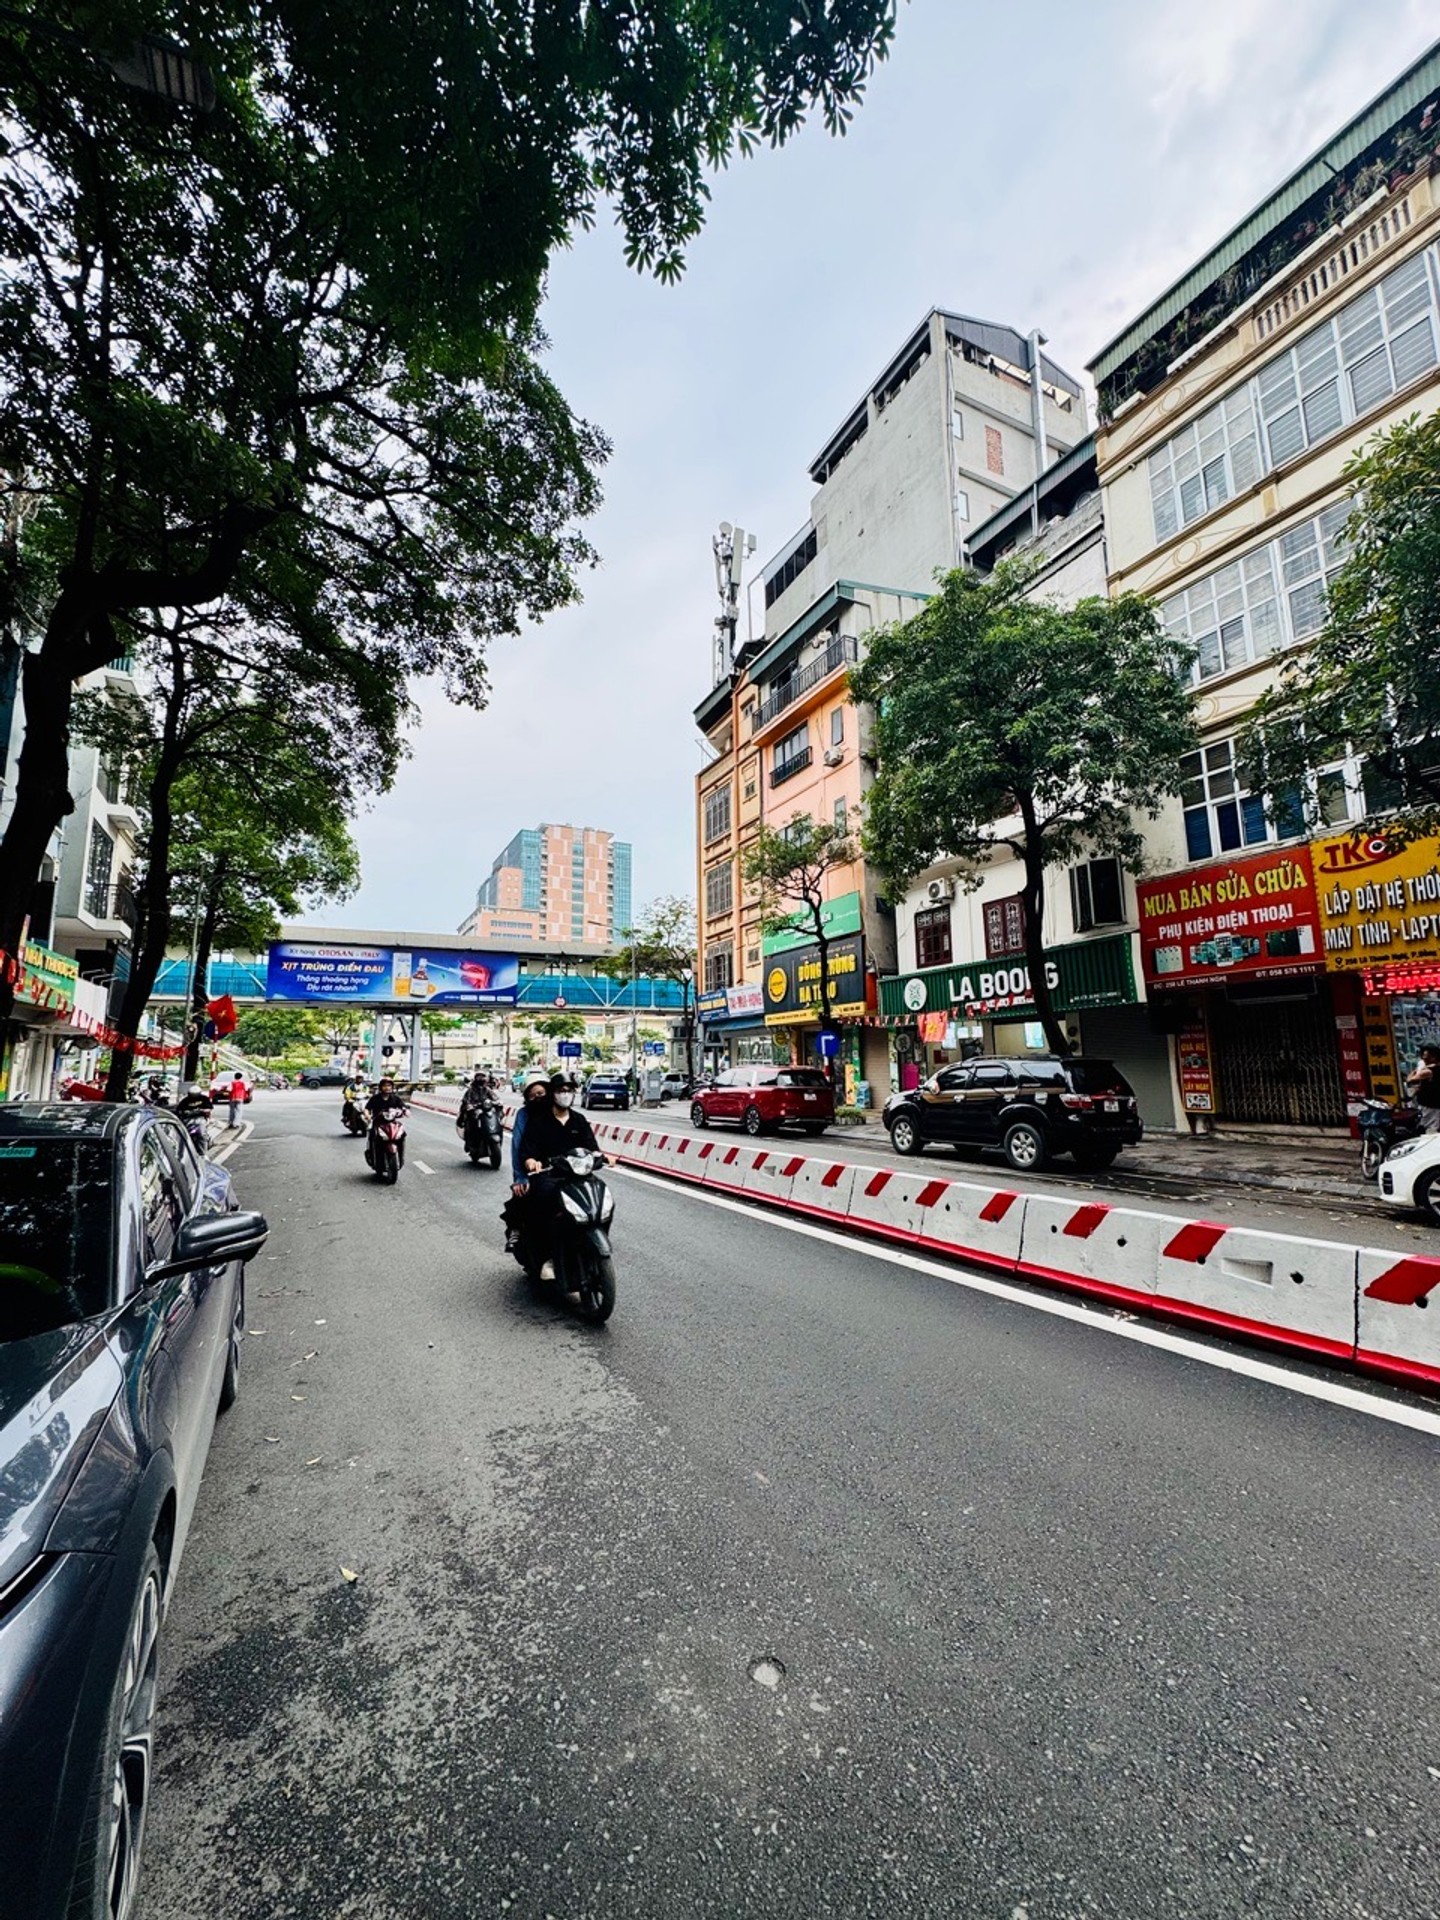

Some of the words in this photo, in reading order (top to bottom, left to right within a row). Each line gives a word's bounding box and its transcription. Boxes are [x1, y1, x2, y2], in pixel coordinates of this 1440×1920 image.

[1144, 893, 1178, 918] MUA
[1180, 880, 1213, 911] BÁN
[1216, 869, 1252, 903] SỬA
[1254, 859, 1308, 896] CHỮA
[1324, 881, 1351, 915] LẮP
[1356, 880, 1382, 914] ĐẶT
[1385, 875, 1406, 909] HỆ
[1158, 922, 1182, 941] PHỤ
[1185, 915, 1214, 936] KIỆN
[1217, 909, 1248, 931] ĐIỆN
[1251, 902, 1294, 924] THOẠI
[1325, 922, 1352, 949] MÁY
[1357, 918, 1391, 945] TÍNH
[282, 961, 299, 972] XỊT
[337, 961, 362, 973] ĐIỂM
[364, 964, 385, 974] ĐAU
[949, 976, 975, 1002] LA
